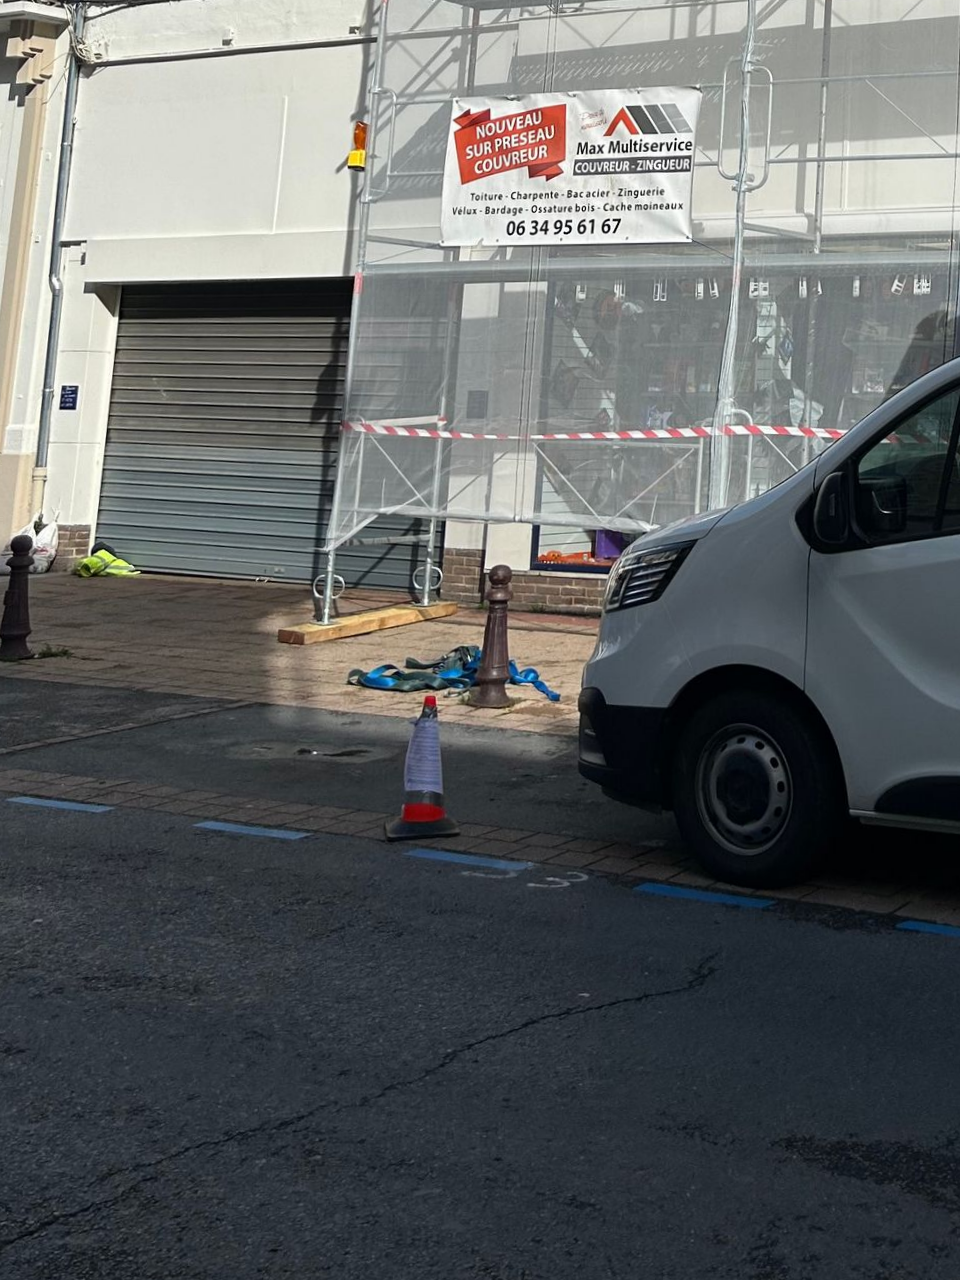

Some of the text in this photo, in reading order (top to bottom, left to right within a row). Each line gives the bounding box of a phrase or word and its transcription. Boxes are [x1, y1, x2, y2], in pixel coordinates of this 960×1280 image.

[476, 110, 542, 140] NOUVEAU
[466, 125, 555, 160] SUR PRESEAU
[577, 138, 692, 155] Max Multiservice
[474, 145, 548, 174] COUVREUR
[575, 159, 630, 173] COUVREUR
[636, 157, 690, 171] ZINGUEUR
[470, 192, 503, 202] Toiture
[511, 190, 559, 202] Charpente
[567, 190, 584, 199] Bac
[585, 189, 610, 198] acier
[618, 187, 665, 199] Zinguerie
[452, 206, 477, 216] Vélux
[484, 206, 523, 216] Bardage
[531, 204, 573, 214] Ossature
[575, 203, 594, 212] bois
[603, 203, 633, 212] Cache
[635, 202, 683, 211] moineaux
[506, 218, 621, 236] 06 34 95 61 67
